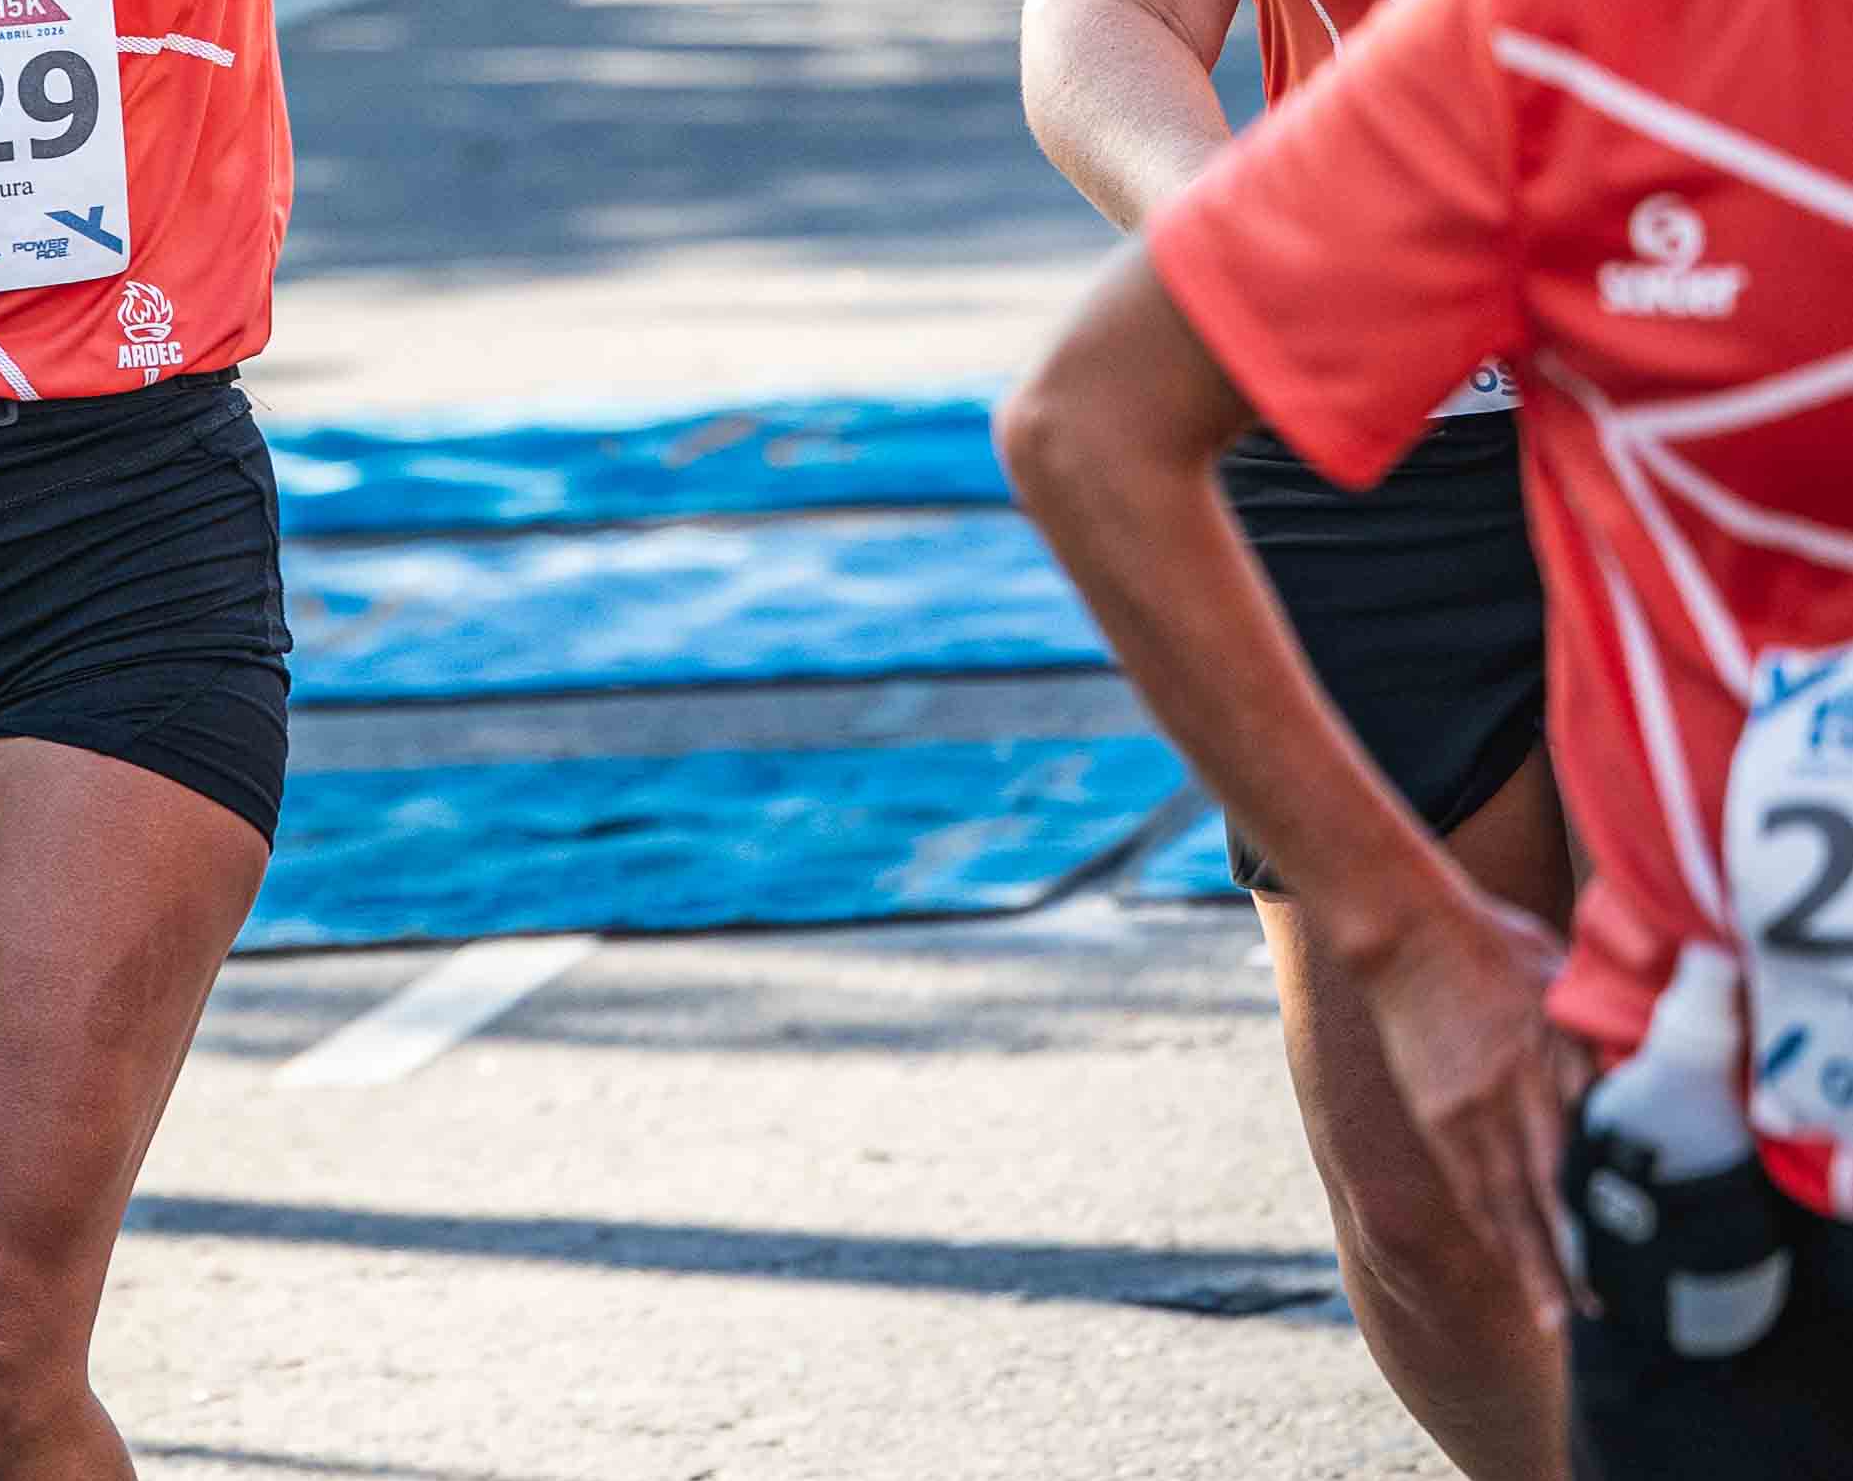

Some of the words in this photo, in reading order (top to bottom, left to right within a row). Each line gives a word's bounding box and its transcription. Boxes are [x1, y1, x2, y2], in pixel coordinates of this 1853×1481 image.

[36, 26, 66, 38] 2026
[12, 237, 69, 253] POWER
[117, 340, 184, 369] ARDEC
